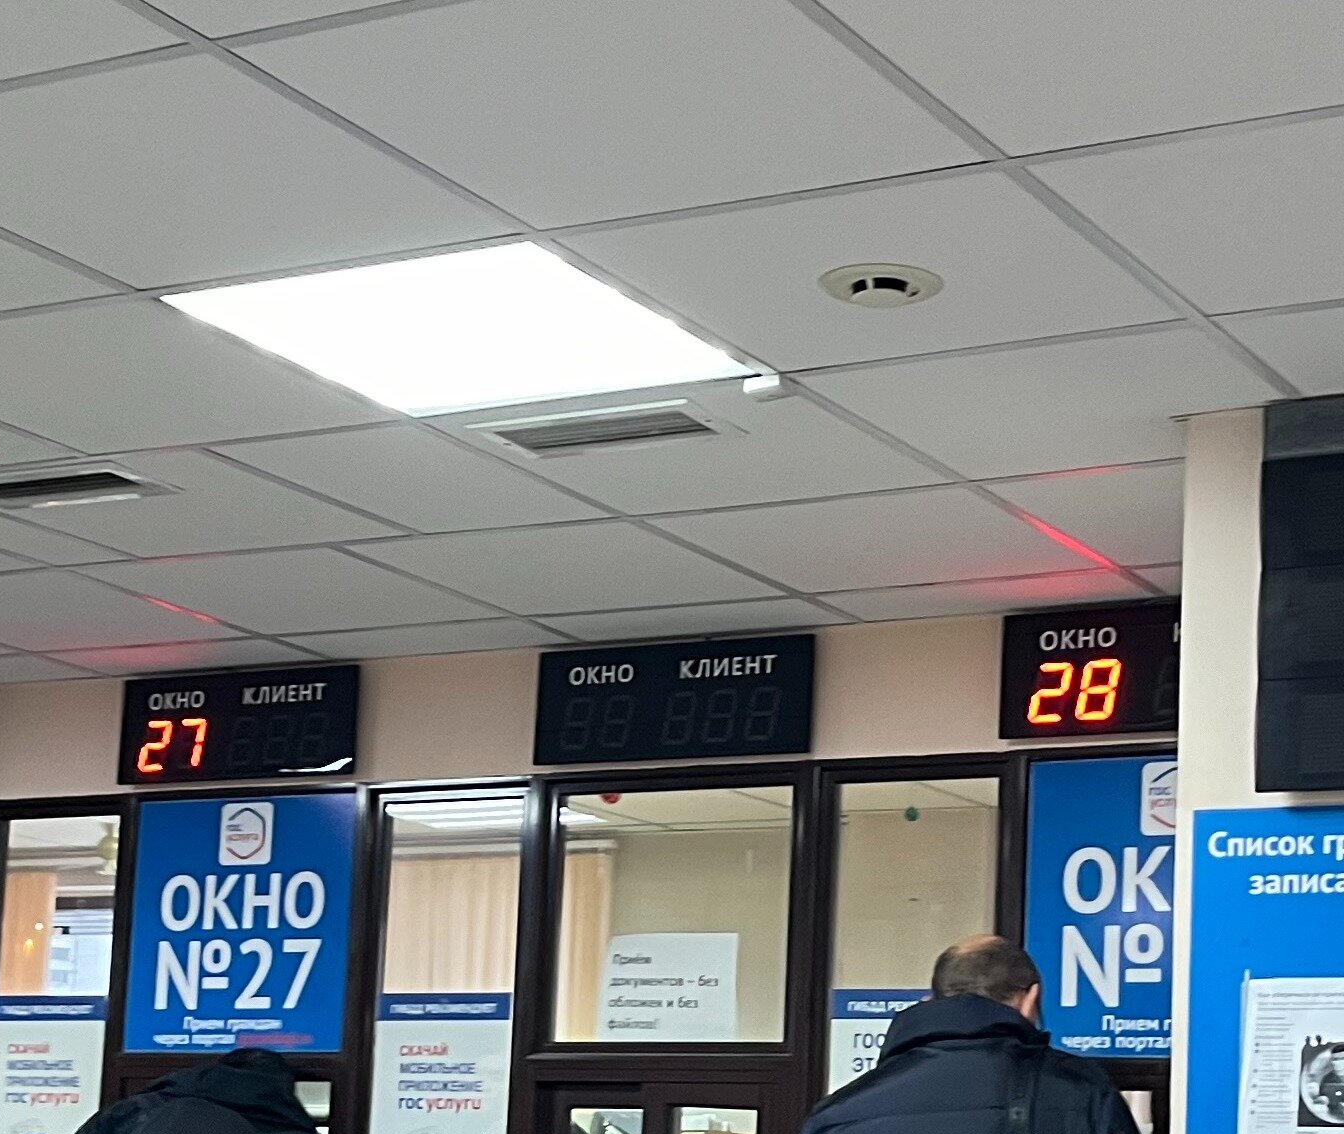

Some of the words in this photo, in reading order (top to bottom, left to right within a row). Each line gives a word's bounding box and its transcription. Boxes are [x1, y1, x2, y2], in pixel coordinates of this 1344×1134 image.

[1039, 627, 1117, 651] ОКНО
[568, 663, 635, 687] ОКНО
[678, 653, 778, 680] КЛИЕНТ
[1027, 658, 1122, 724] 28
[148, 690, 205, 711] ОКНО
[241, 683, 327, 706] КЛИЕНТ
[136, 717, 209, 773] 27
[1207, 831, 1315, 858] Список
[160, 870, 326, 932] ОКНО
[1062, 845, 1172, 914] ОК
[153, 938, 323, 1011] №27
[1101, 1014, 1160, 1035] Прием
